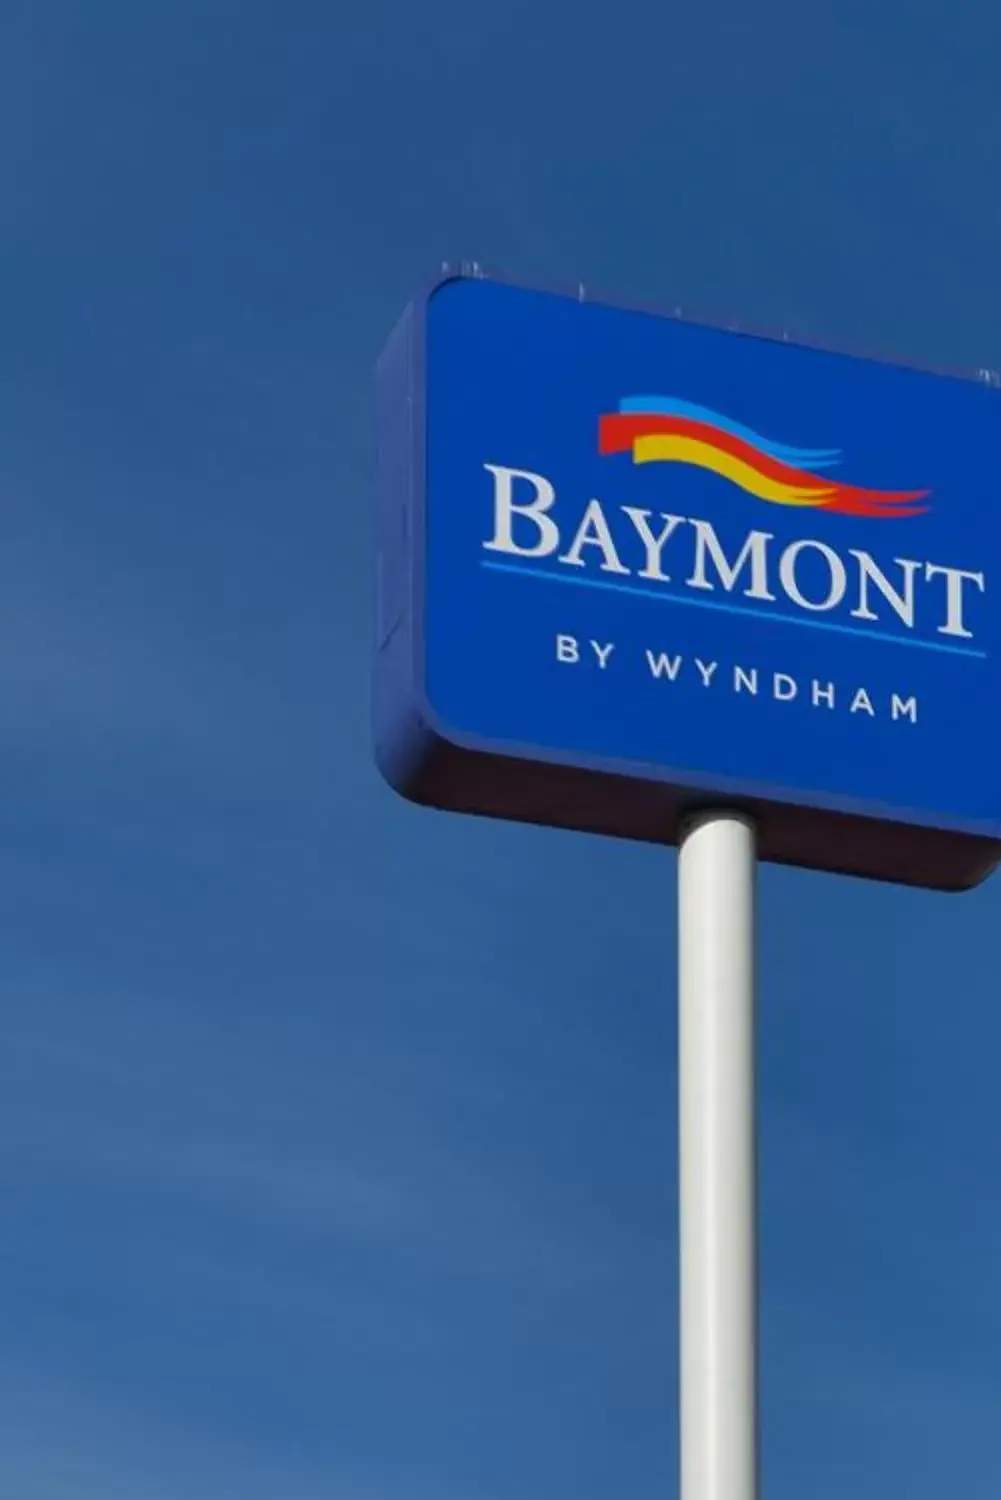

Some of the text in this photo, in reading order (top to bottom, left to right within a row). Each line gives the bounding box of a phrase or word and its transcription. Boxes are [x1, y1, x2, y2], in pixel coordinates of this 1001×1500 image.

[482, 463, 985, 639] BAYMONT
[556, 634, 918, 724] BY WYNDHAM
